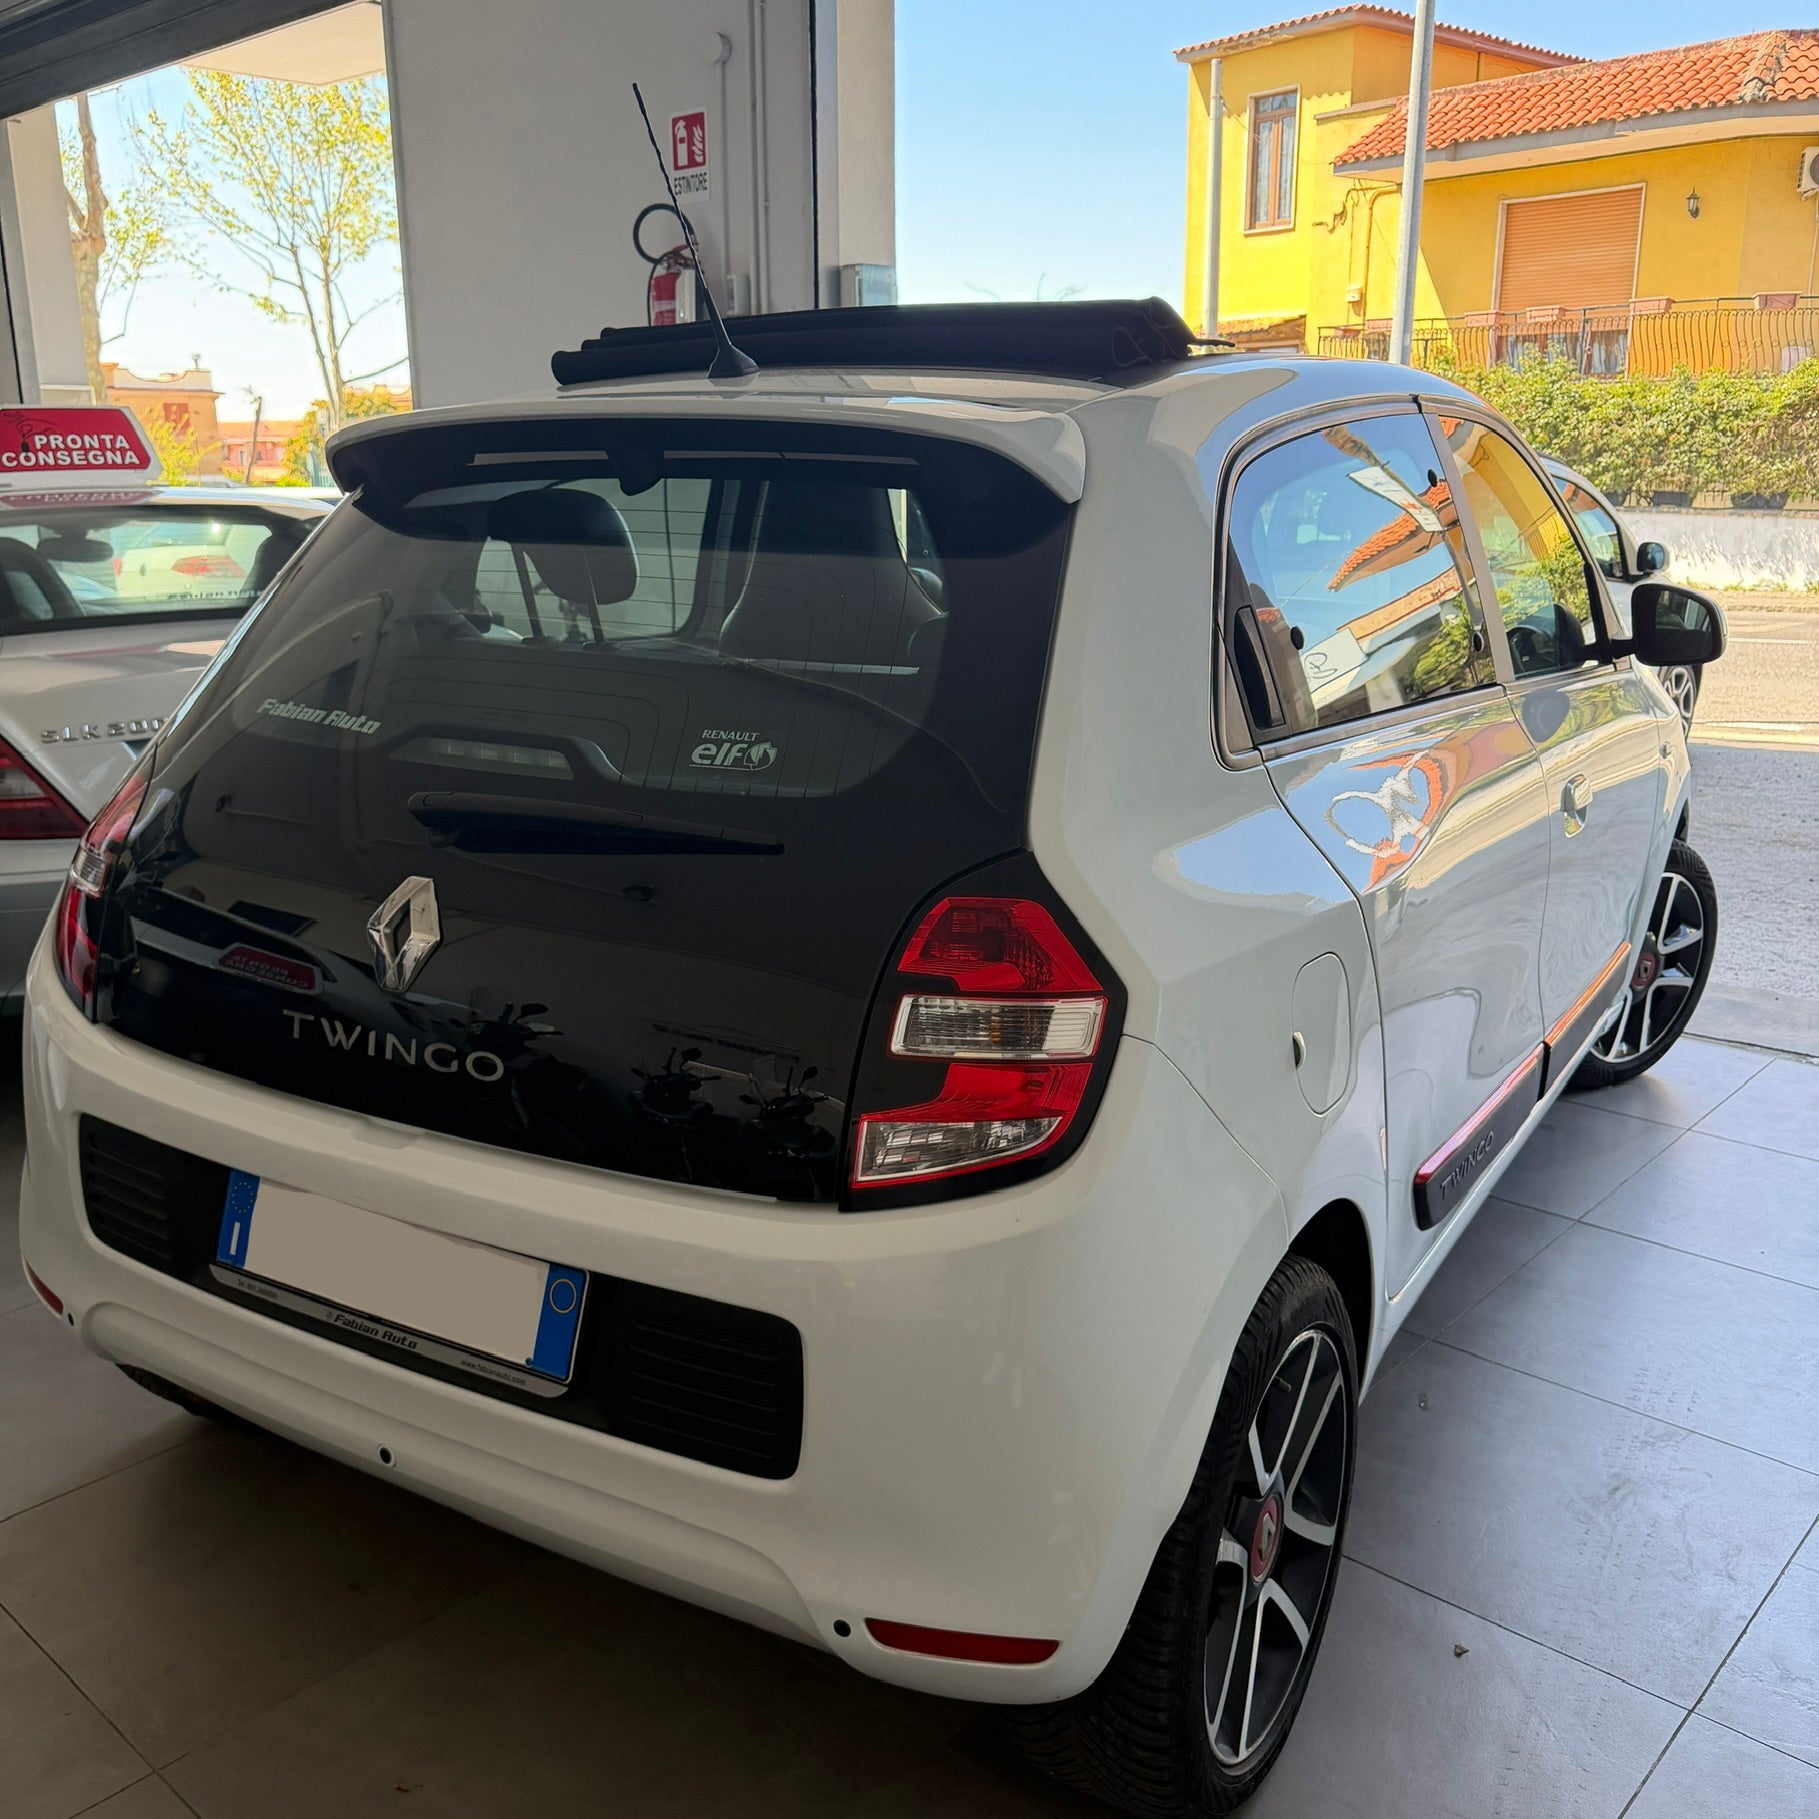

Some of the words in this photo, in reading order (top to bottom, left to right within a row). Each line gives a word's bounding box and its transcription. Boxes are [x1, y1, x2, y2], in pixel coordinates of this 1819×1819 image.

[673, 172, 708, 195] ESTINTORE
[33, 434, 131, 449] PRONTA
[1, 450, 140, 468] CONSEGNA
[257, 698, 327, 723] Fabian
[323, 710, 381, 735] Auto
[41, 723, 102, 743] SLK
[701, 729, 760, 742] RENAULT
[691, 742, 749, 766] elf
[283, 1009, 504, 1082] TWINGO
[1440, 1130, 1494, 1200] TWINGO
[334, 1313, 380, 1336] Fabian
[381, 1330, 418, 1350] Auto
